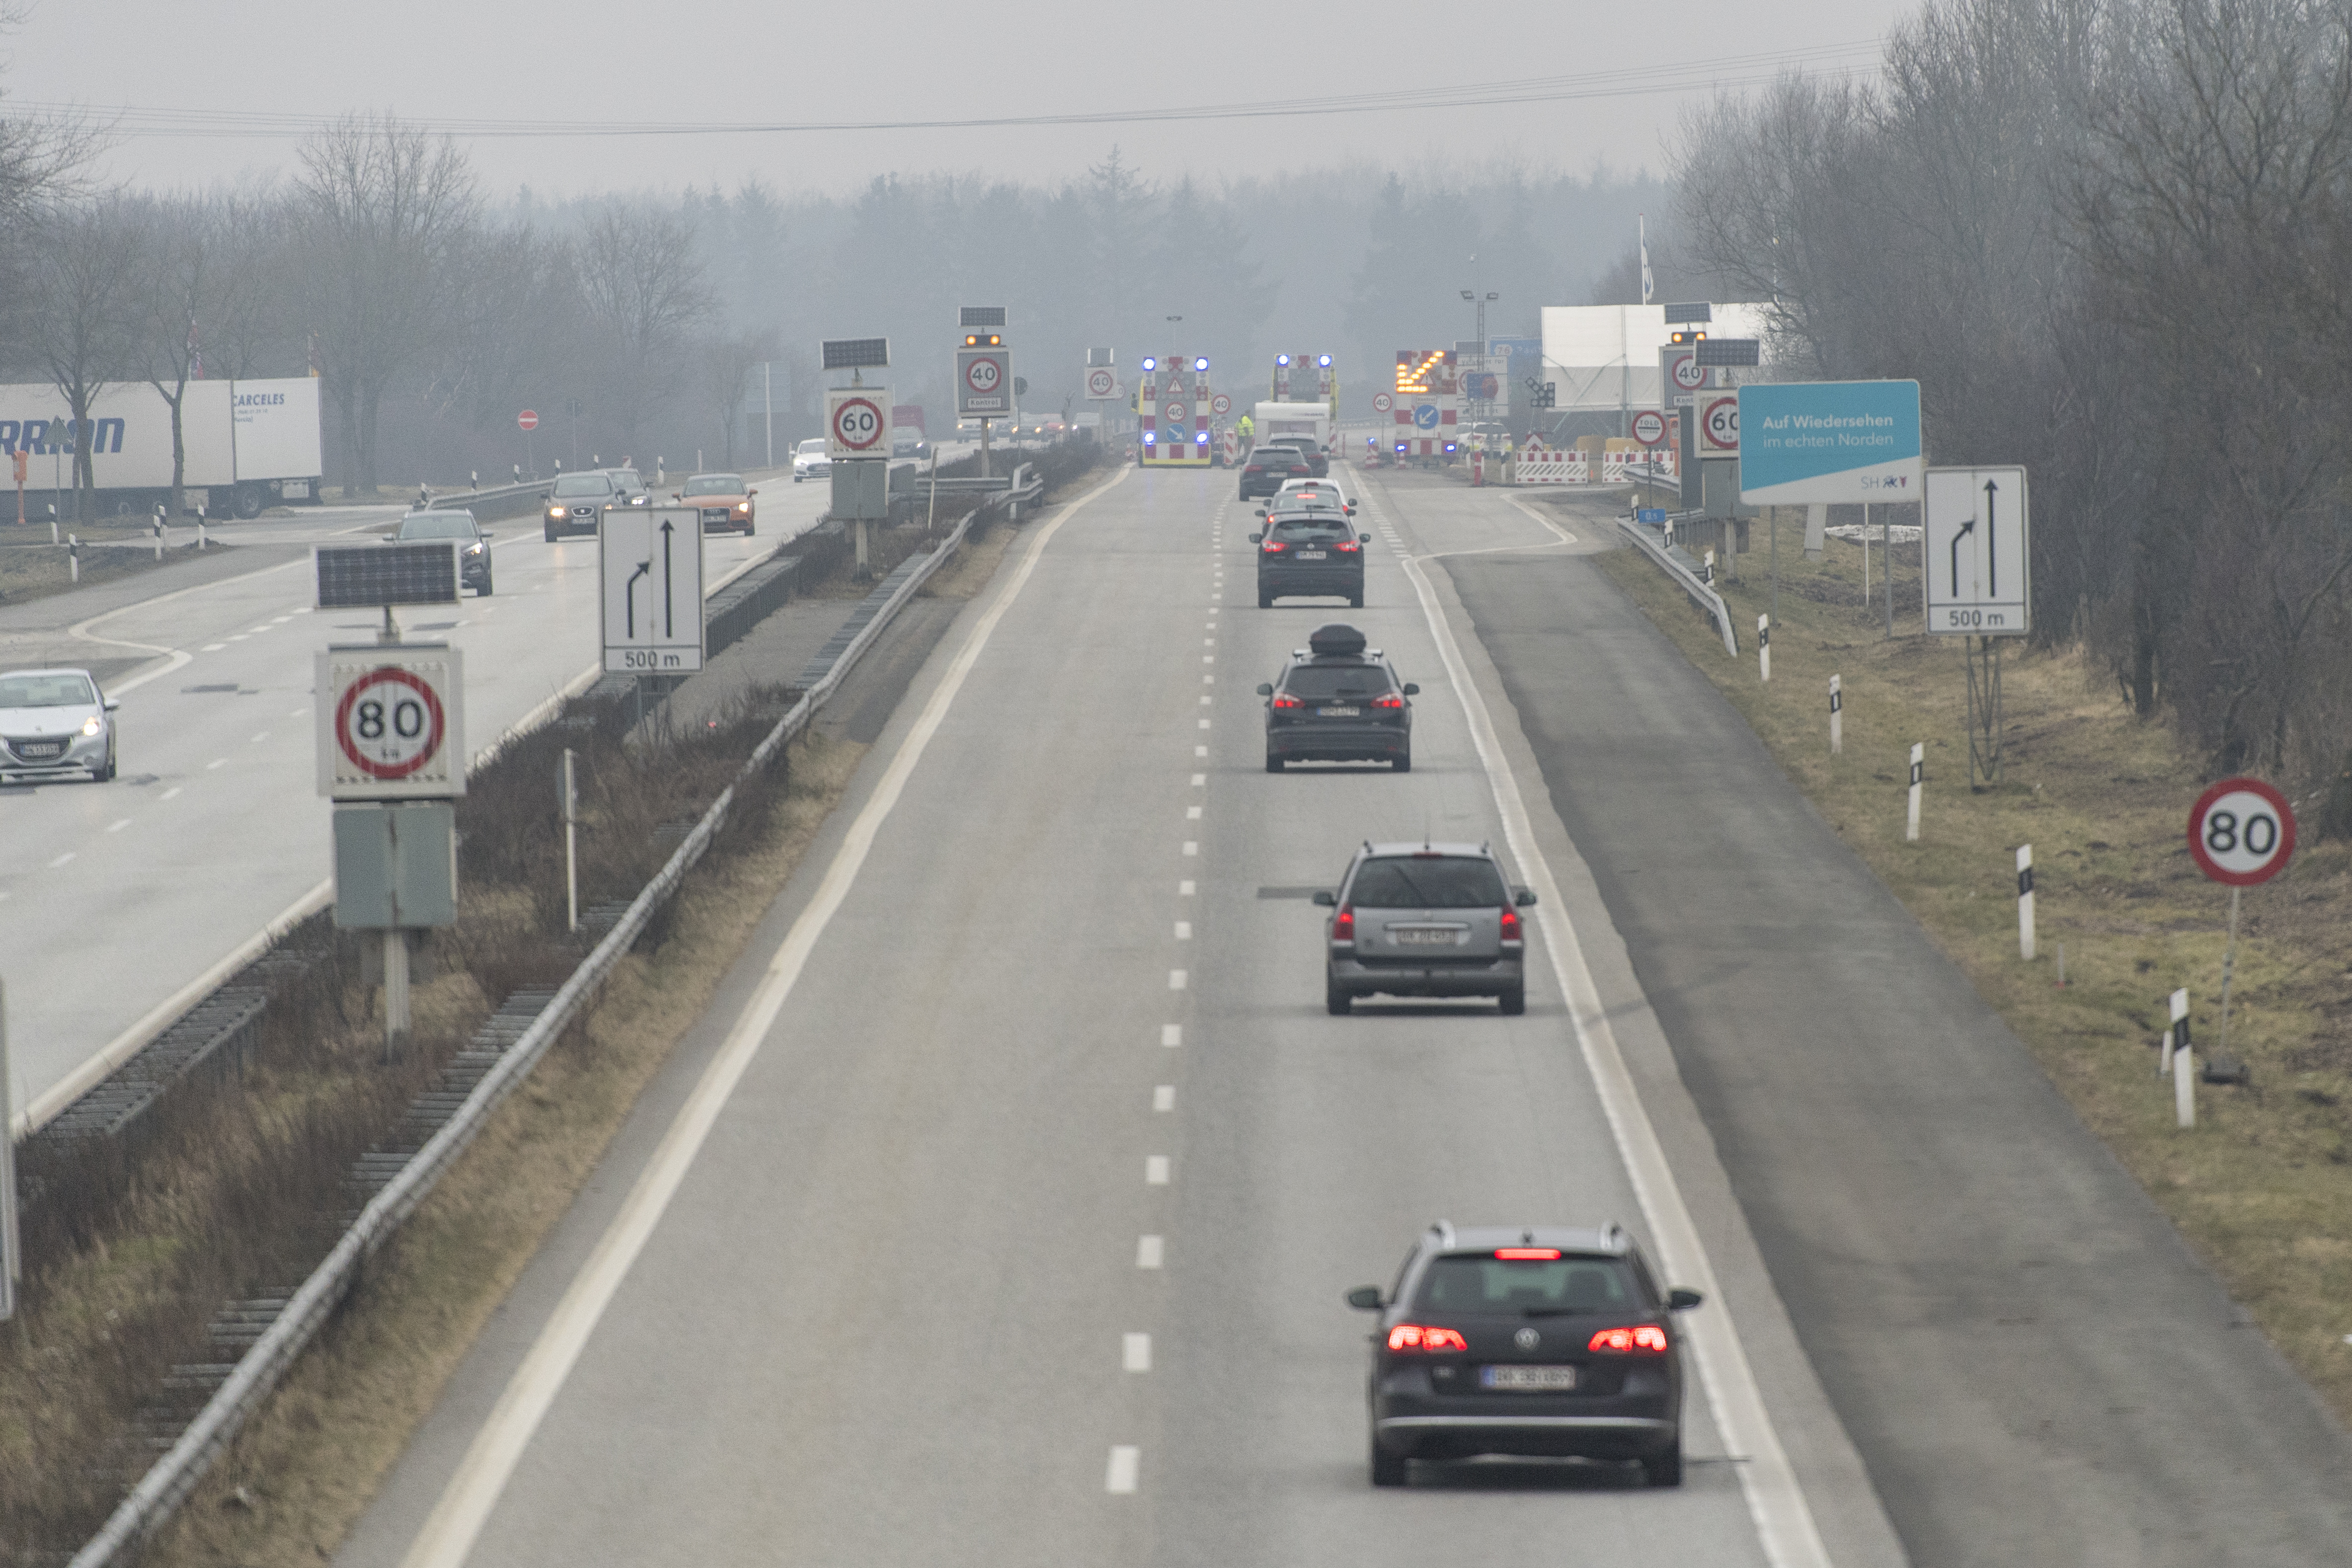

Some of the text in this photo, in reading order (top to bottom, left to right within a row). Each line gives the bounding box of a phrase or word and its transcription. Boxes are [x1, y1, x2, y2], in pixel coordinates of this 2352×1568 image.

[972, 367, 996, 381] 40
[1679, 367, 1700, 379] 40
[1094, 378, 1108, 386] 40
[1169, 407, 1183, 416] 40
[1215, 400, 1227, 408] 40
[843, 412, 873, 431] 60
[1713, 412, 1738, 431] 60
[1763, 413, 1893, 429] Auf Wiedersehen
[1764, 432, 1893, 448] im echten Norden
[1949, 610, 2004, 627] 500 m
[625, 650, 681, 668] 500 m
[358, 700, 423, 739] 80
[2208, 809, 2277, 856] 80
